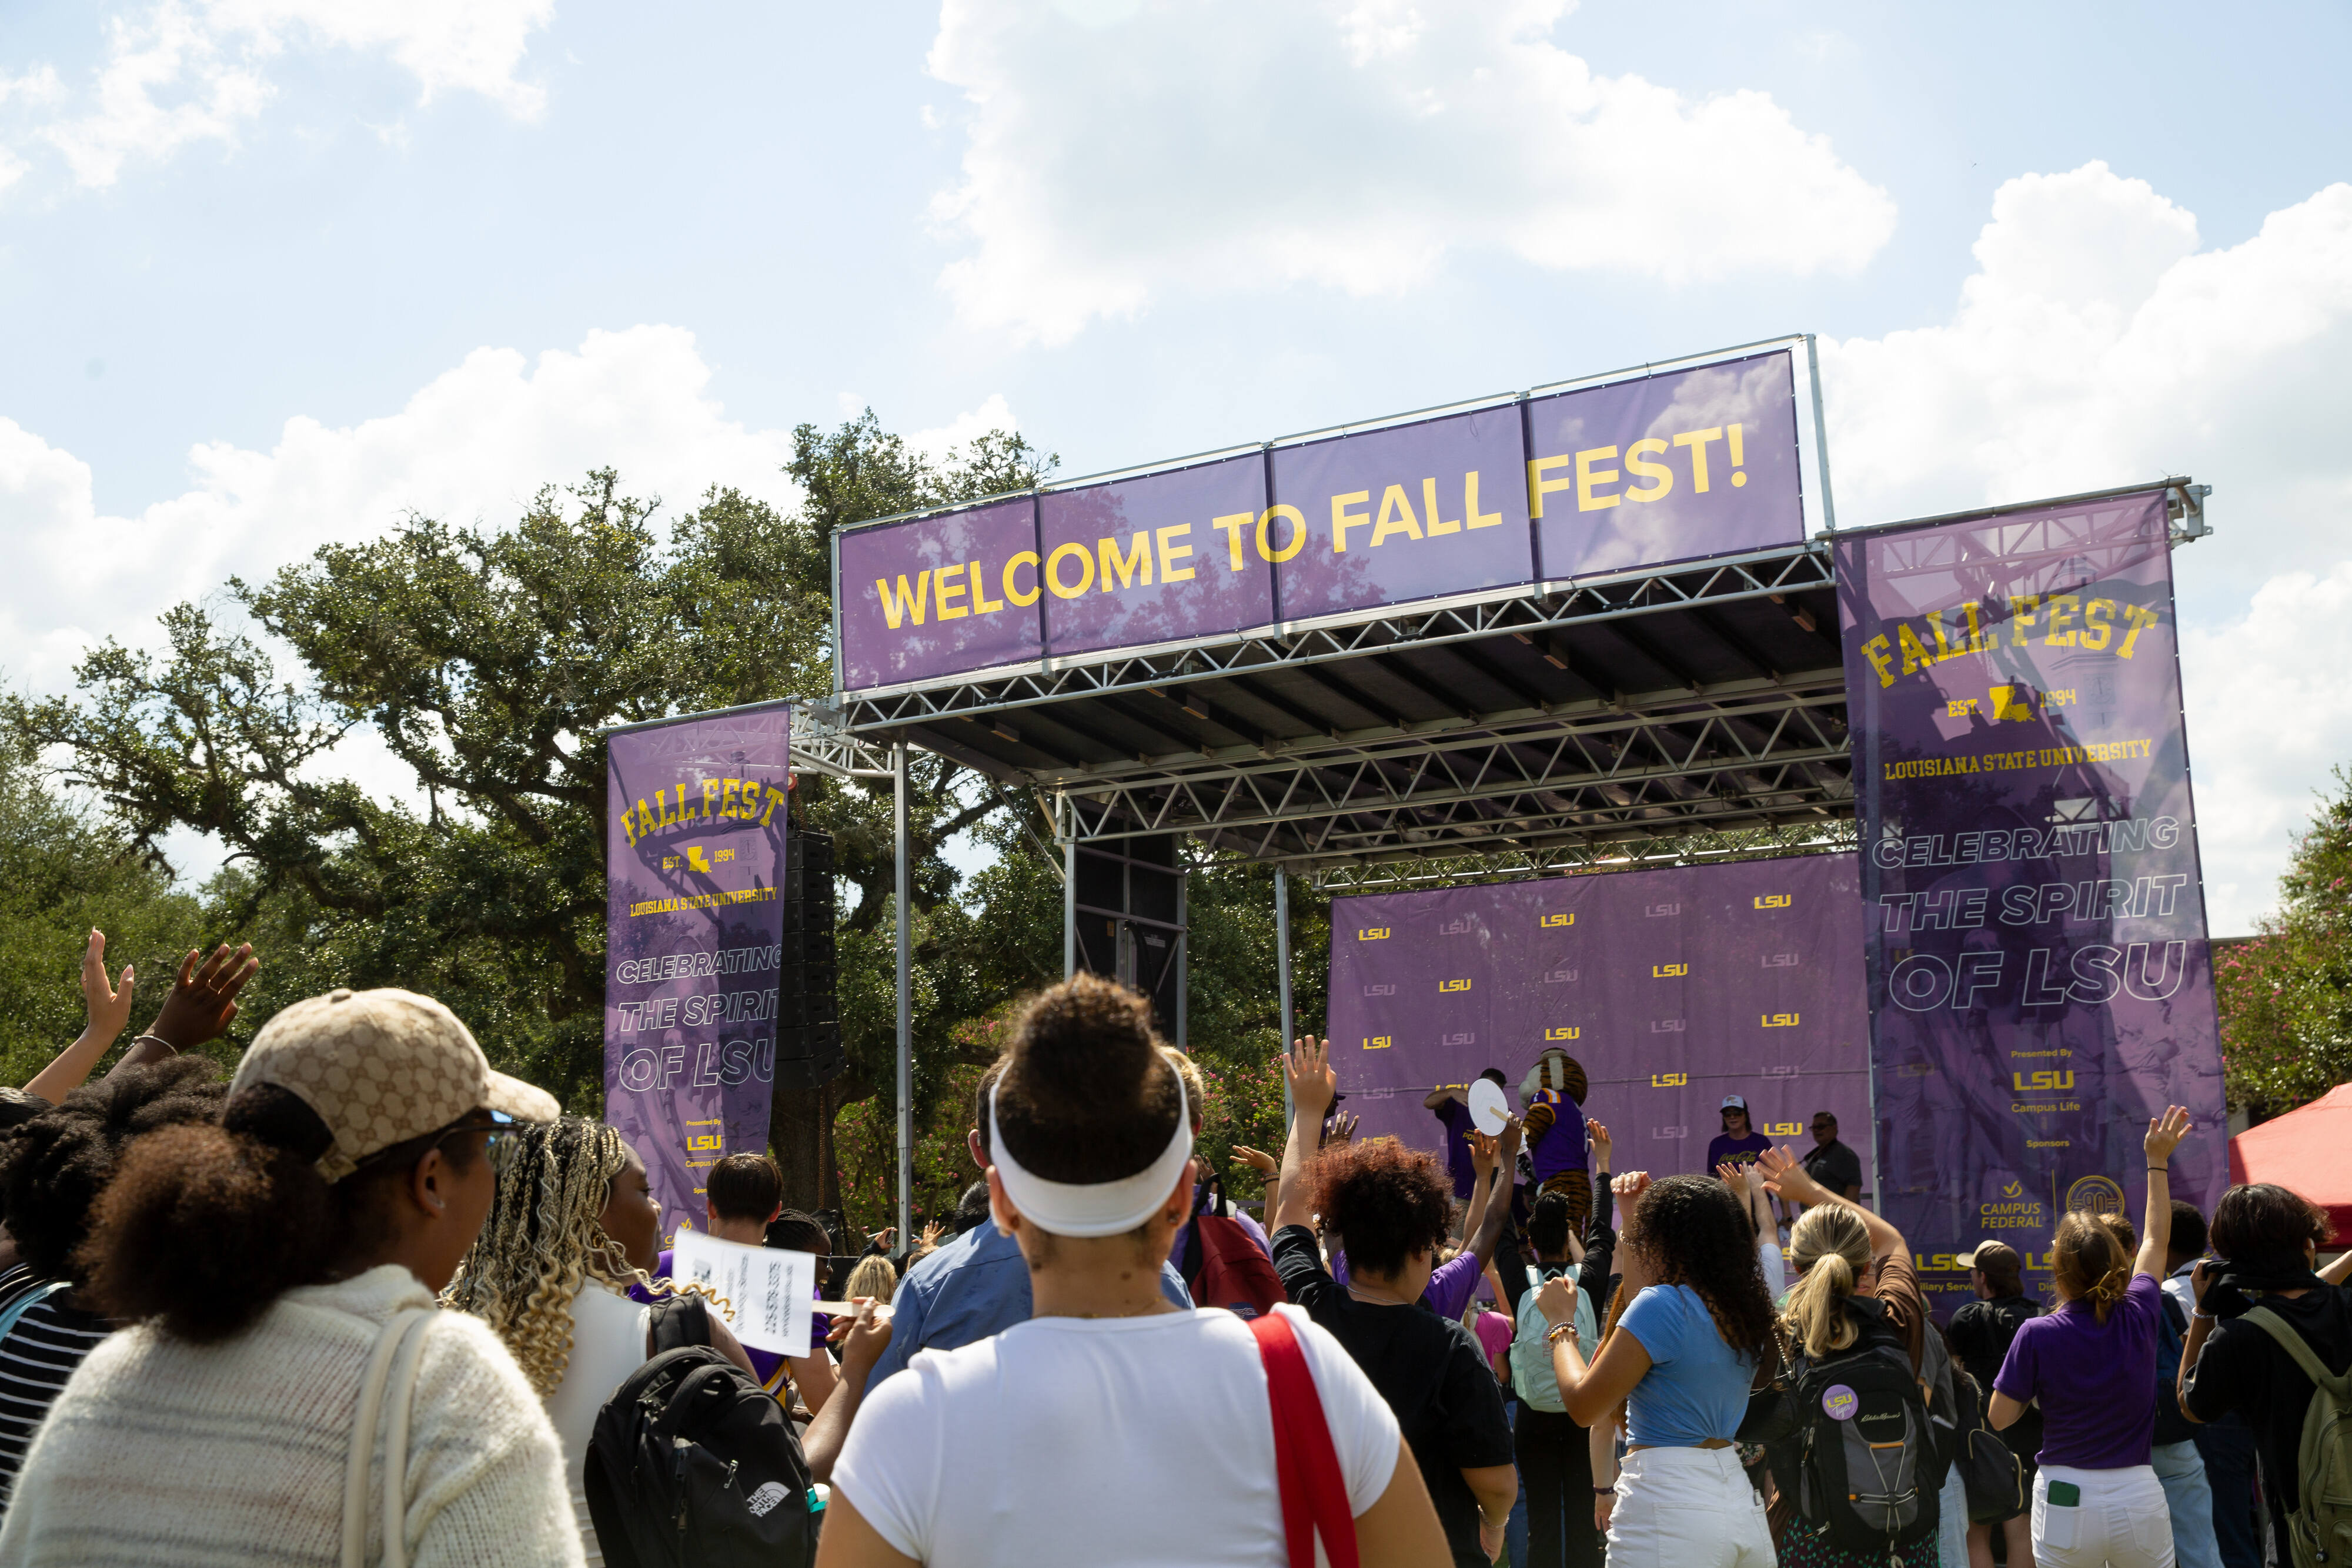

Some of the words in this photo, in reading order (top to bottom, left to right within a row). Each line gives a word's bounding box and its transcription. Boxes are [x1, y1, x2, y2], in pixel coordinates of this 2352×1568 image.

[876, 523, 1195, 629] WELCOME
[1213, 504, 1307, 571] TO
[1331, 471, 1502, 553] FALL
[1528, 423, 1748, 519] FEST!
[1861, 601, 1999, 688] FALL
[2009, 594, 2159, 660] FEST
[1947, 698, 1983, 717] EST.
[2040, 688, 2077, 708] 1994
[1885, 755, 1980, 780] LOUISIANA
[1983, 750, 2036, 772] STATE
[2040, 738, 2152, 767] UNIVERSITY
[621, 783, 696, 848] FALL
[701, 778, 785, 828] FEST
[1872, 815, 2179, 869] CELEBRATING
[662, 855, 683, 870] EST.
[714, 848, 735, 863] 1994
[630, 898, 680, 917] LOUISIANA
[681, 894, 711, 910] STATE
[712, 887, 778, 907] UNIVERSITY
[1755, 894, 1791, 909] LSU
[1879, 888, 1989, 932] THE
[1999, 874, 2187, 925] SPIRIT
[1646, 903, 1681, 917] LSU
[1541, 914, 1574, 928] LSU
[1359, 928, 1390, 941] LSU
[616, 944, 781, 984] CELEBRATING
[1762, 954, 1798, 968] LSU
[1544, 969, 1578, 984] LSU
[1653, 964, 1688, 978] LSU
[1889, 951, 2004, 1011] OF
[2022, 940, 2187, 1006] LSU
[1364, 984, 1395, 997] LSU
[1439, 979, 1471, 992] LSU
[618, 998, 678, 1032] THE
[1762, 1013, 1799, 1027] LSU
[1651, 1019, 1686, 1032] LSU
[1442, 1032, 1475, 1047] LSU
[1545, 1027, 1579, 1041] LSU
[1363, 1036, 1391, 1049] LSU
[2011, 1049, 2058, 1058] Presented
[2060, 1048, 2073, 1058] By
[619, 1045, 684, 1092] OF
[694, 1037, 776, 1088] LSU
[1652, 1073, 1687, 1087] LSU
[2013, 1070, 2074, 1091] LSU
[1362, 1087, 1394, 1100] LSU
[2011, 1104, 2057, 1114] Campus
[2060, 1102, 2081, 1111] Life
[1652, 1125, 1688, 1139] LSU
[1764, 1122, 1802, 1136] LSU
[687, 1135, 721, 1151] LSU
[2026, 1139, 2070, 1149] Sponsors
[685, 1161, 711, 1169] Campus
[1980, 1202, 2042, 1215] CAMPUS
[1981, 1216, 2043, 1229] FEDERAL
[2026, 1252, 2054, 1270] LS
[1920, 1282, 1945, 1293] iliary
[1826, 1393, 1853, 1408] LSU
[746, 1487, 765, 1504] THE
[749, 1493, 772, 1514] ORTH
[756, 1499, 779, 1517] FACE
